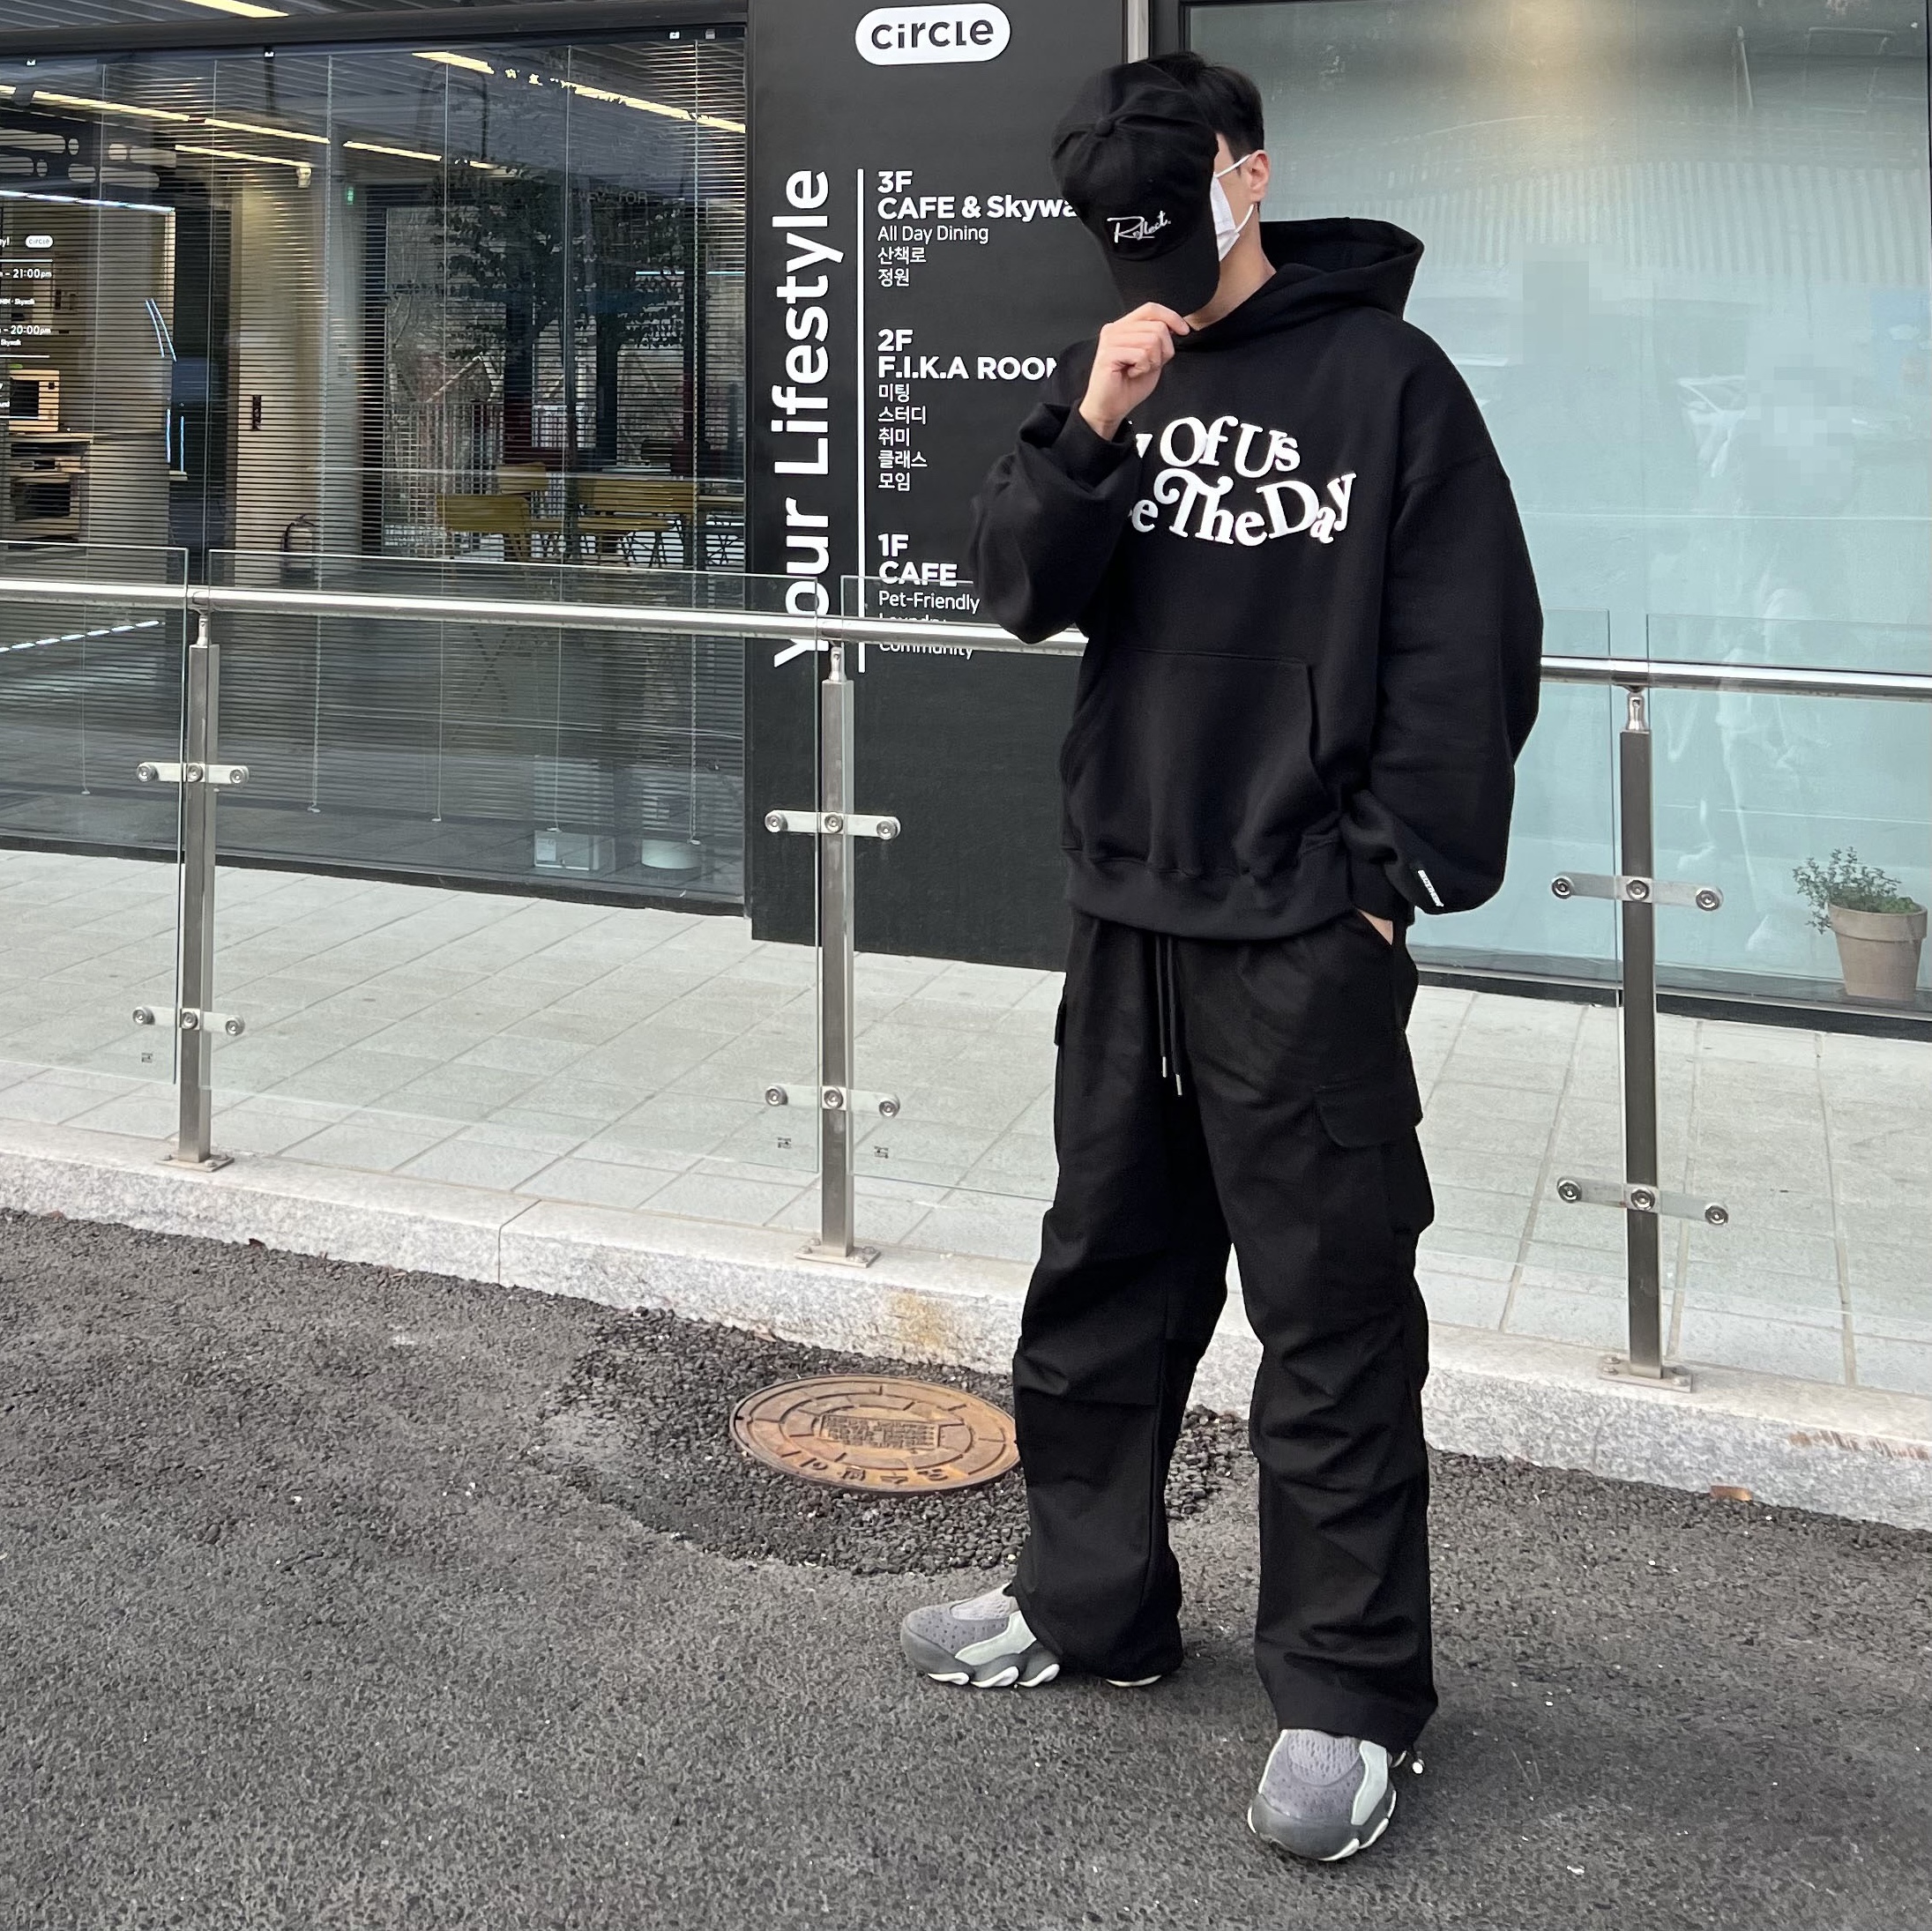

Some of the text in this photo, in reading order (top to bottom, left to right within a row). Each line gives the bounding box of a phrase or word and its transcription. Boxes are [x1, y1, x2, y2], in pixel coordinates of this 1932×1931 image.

[871, 19, 994, 49] circle
[878, 171, 914, 193] 3F
[878, 197, 955, 220] CAFE
[962, 196, 981, 219] &
[878, 225, 989, 245] All Day Dining
[877, 246, 927, 265] 산책로
[877, 268, 910, 287] 정원
[772, 170, 844, 474] Lifestyle
[878, 329, 914, 352] 2F
[878, 356, 970, 379] F.I.K.A
[878, 383, 910, 403] 미팅
[877, 406, 926, 425] 스터디
[877, 428, 910, 447] 취미
[877, 450, 928, 469] 클래스
[877, 472, 910, 492] 모임
[878, 533, 909, 557] 1F
[878, 560, 958, 587] CAFE
[878, 590, 981, 615] Pet-Friendly
